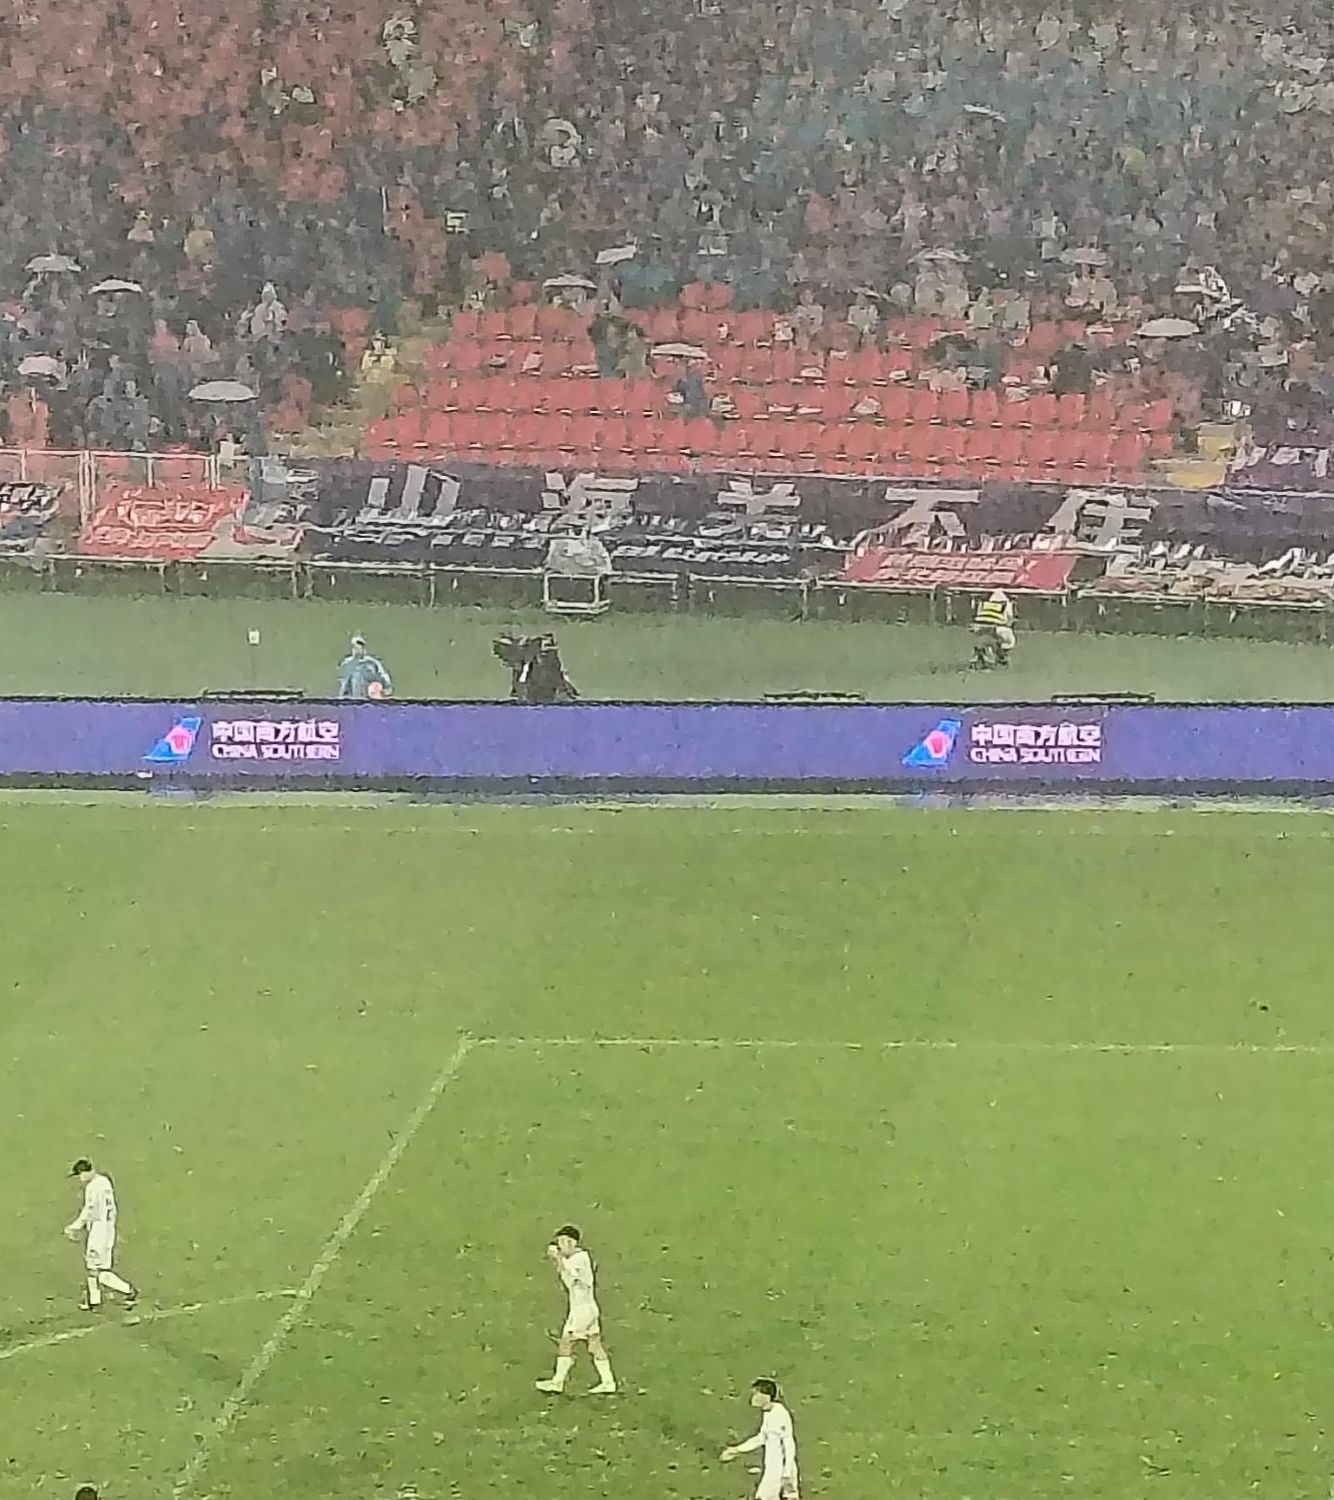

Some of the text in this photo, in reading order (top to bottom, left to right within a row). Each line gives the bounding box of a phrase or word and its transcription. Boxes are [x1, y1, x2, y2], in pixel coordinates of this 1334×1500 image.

[211, 720, 340, 743] 中国南方航空
[970, 723, 1101, 746] 中国南方航空
[211, 744, 257, 759] CHINA
[970, 747, 1101, 762] CHINA SOUTHERN
